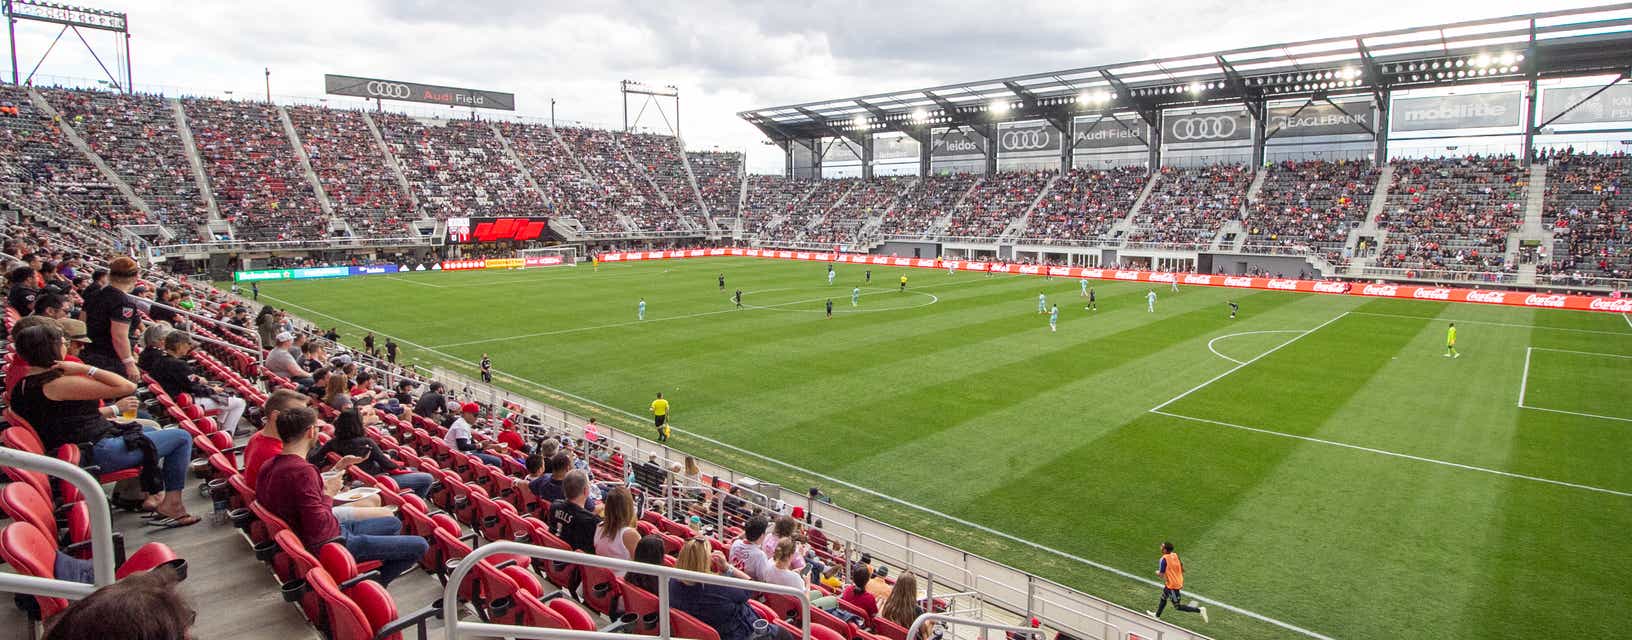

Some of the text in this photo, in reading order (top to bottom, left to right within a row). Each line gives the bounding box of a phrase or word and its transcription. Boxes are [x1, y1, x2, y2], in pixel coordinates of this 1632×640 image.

[424, 89, 484, 104] Audi Field
[1287, 114, 1367, 128] EAGLEBANK
[1077, 127, 1140, 140] Audi Field
[946, 139, 976, 151] leidos
[1363, 284, 1397, 296] Coca-Cola
[1413, 287, 1449, 300] Coca-Cola
[1467, 290, 1504, 303] Coca-Cola
[1525, 294, 1566, 307] Coca-Cola
